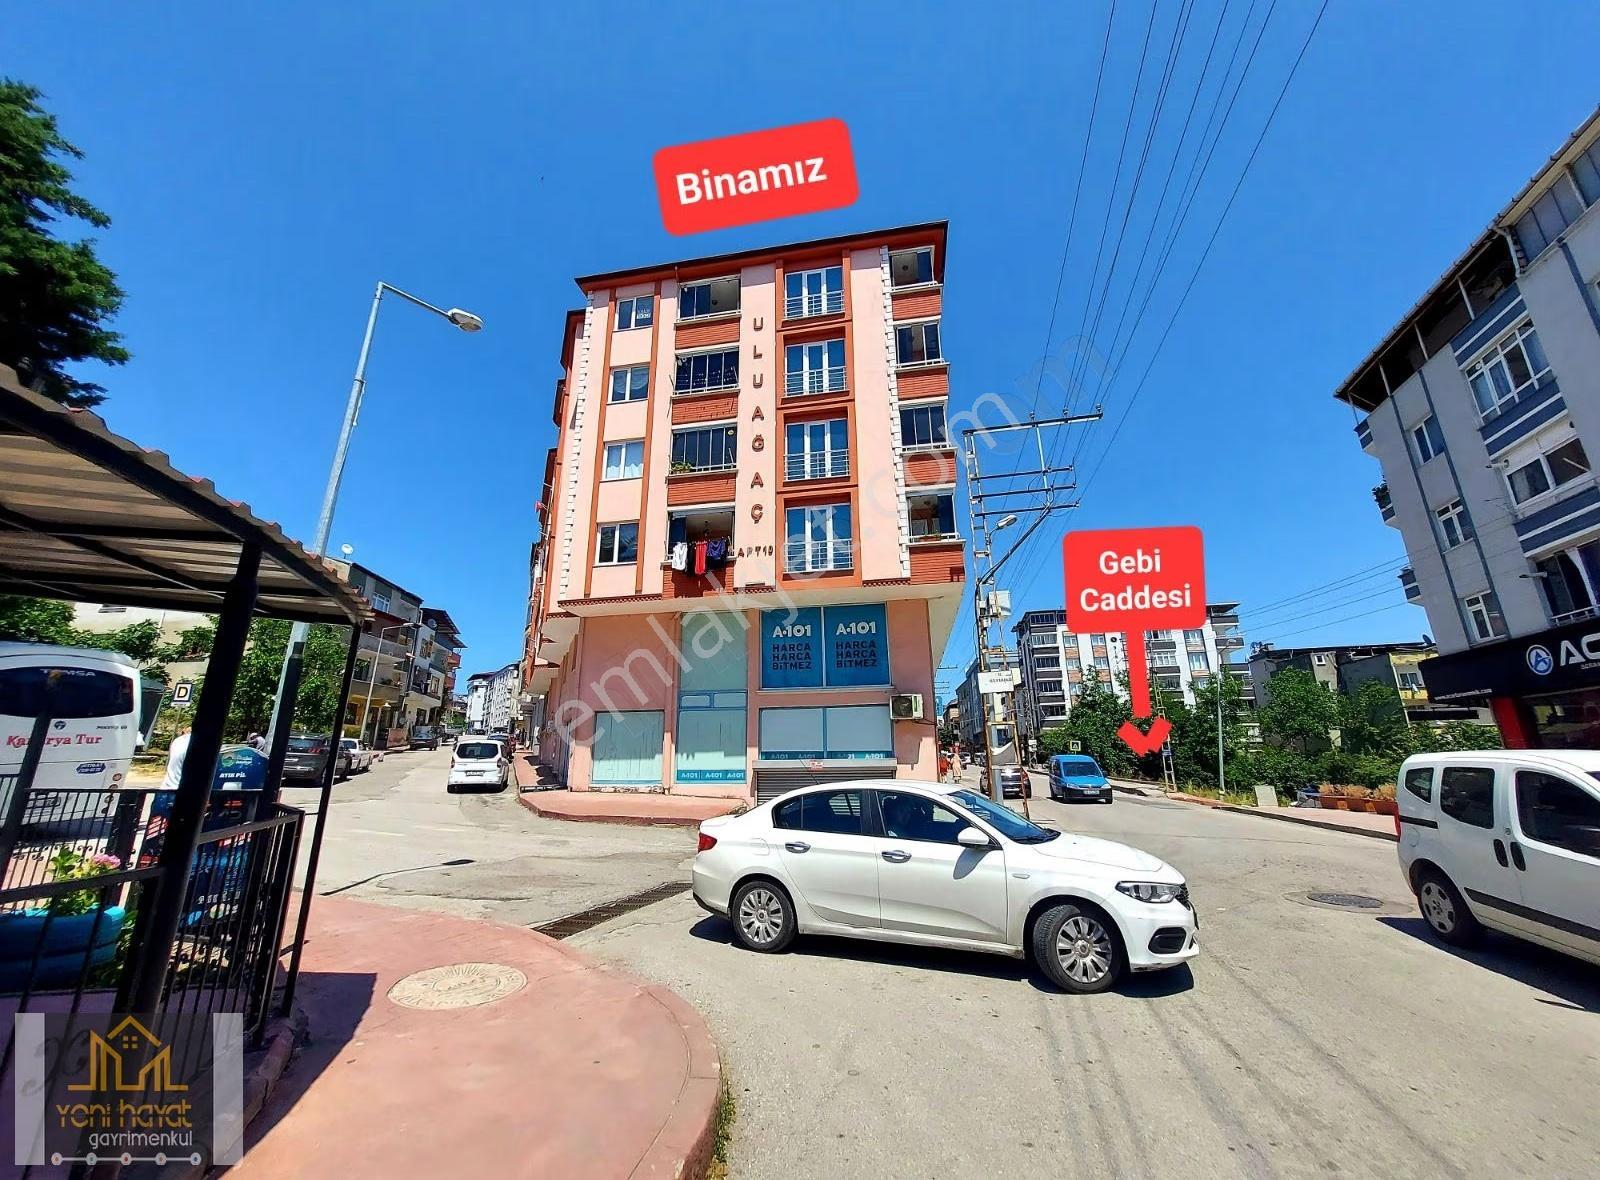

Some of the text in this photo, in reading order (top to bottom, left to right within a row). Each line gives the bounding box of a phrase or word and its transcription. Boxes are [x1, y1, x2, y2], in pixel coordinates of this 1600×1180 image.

[772, 643, 812, 653] HARCA
[835, 640, 877, 650] HARCA
[772, 653, 812, 662] HARCA
[835, 650, 877, 660] HARCA
[177, 686, 190, 699] D
[75, 733, 103, 745] Tur
